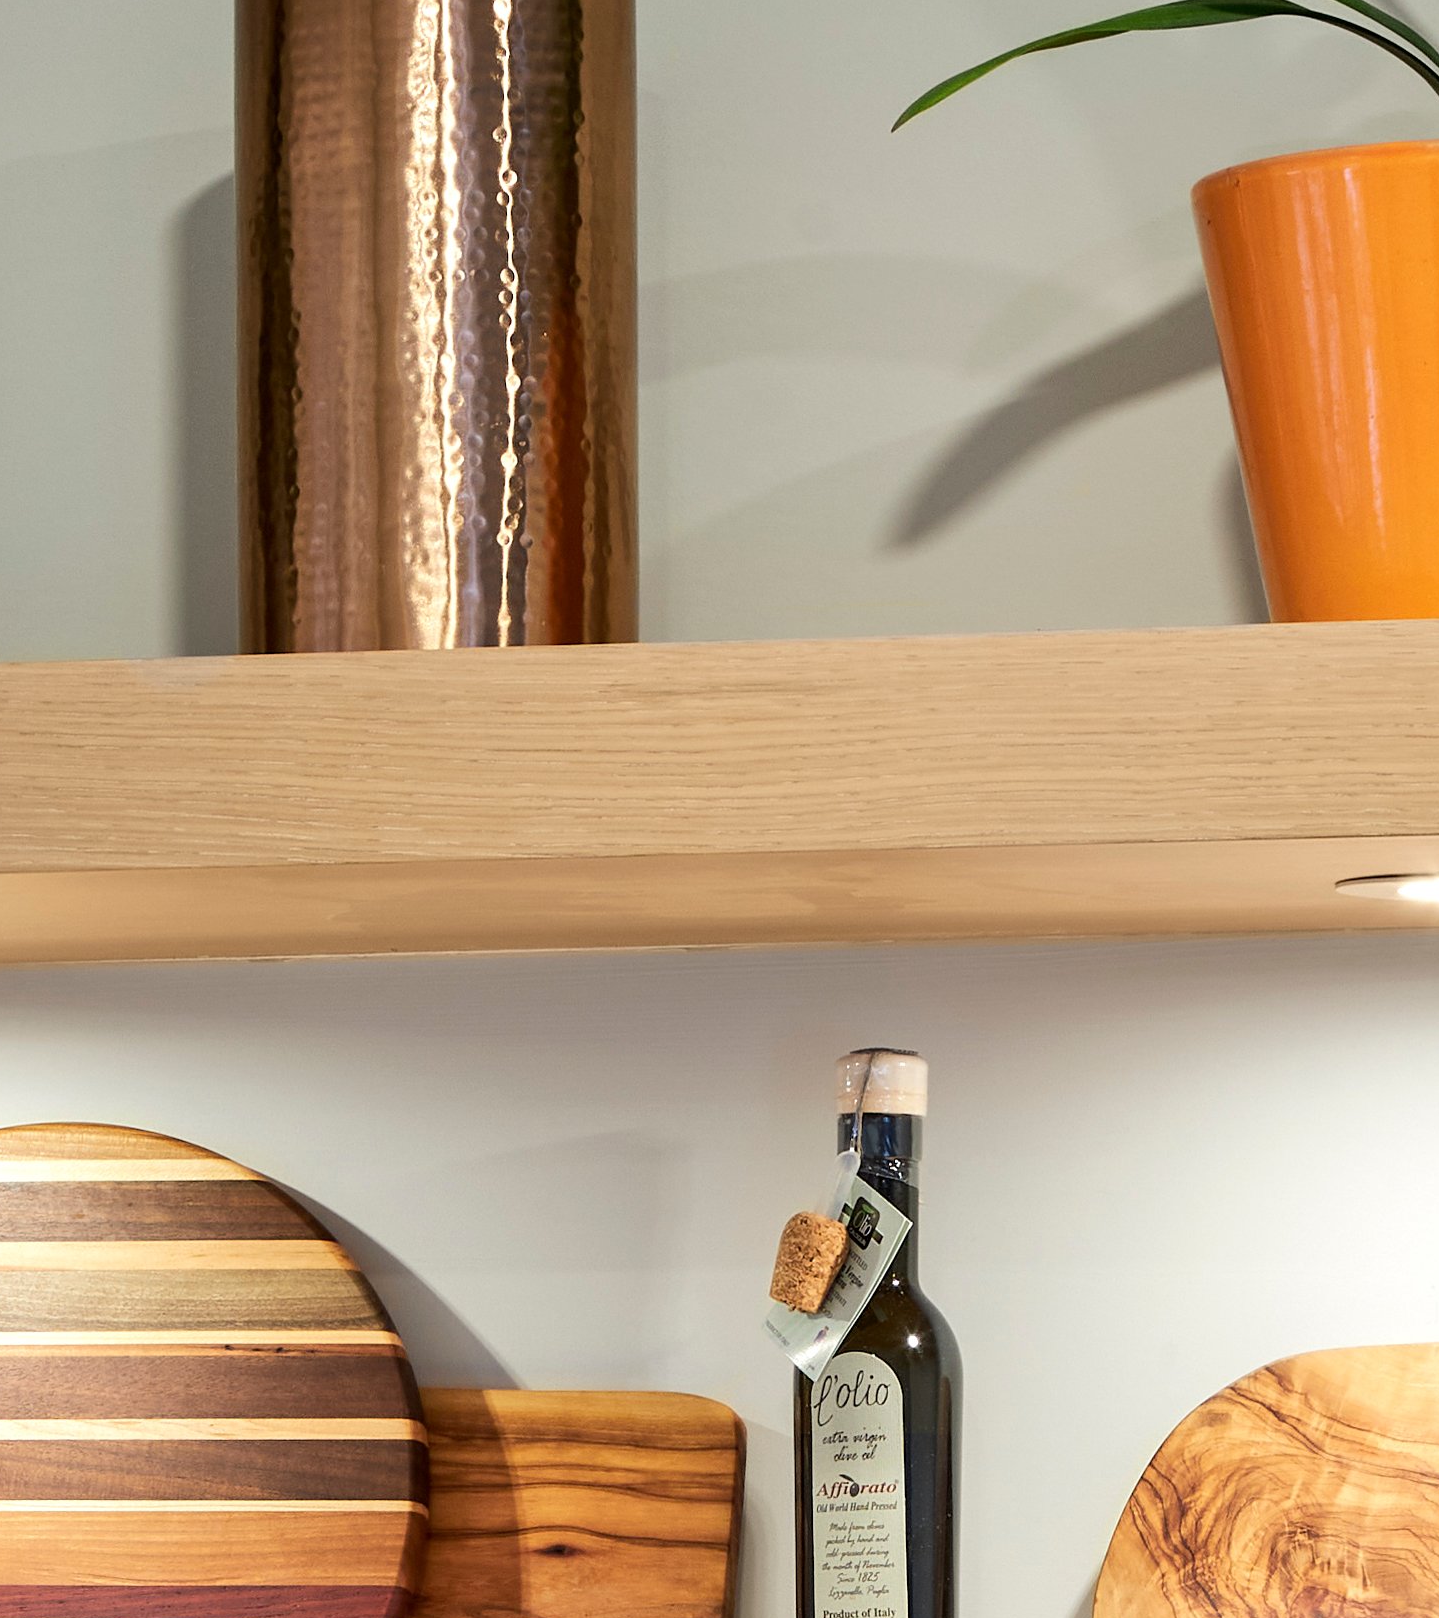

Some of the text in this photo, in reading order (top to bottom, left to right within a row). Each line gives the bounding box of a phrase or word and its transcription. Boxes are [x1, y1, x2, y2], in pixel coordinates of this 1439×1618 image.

[823, 1426, 887, 1448] extra virgin
[834, 1444, 877, 1462] olive oil
[817, 1500, 897, 1514] Old World Hand Pressed
[859, 1571, 880, 1583] 1825
[862, 1608, 871, 1618] of
